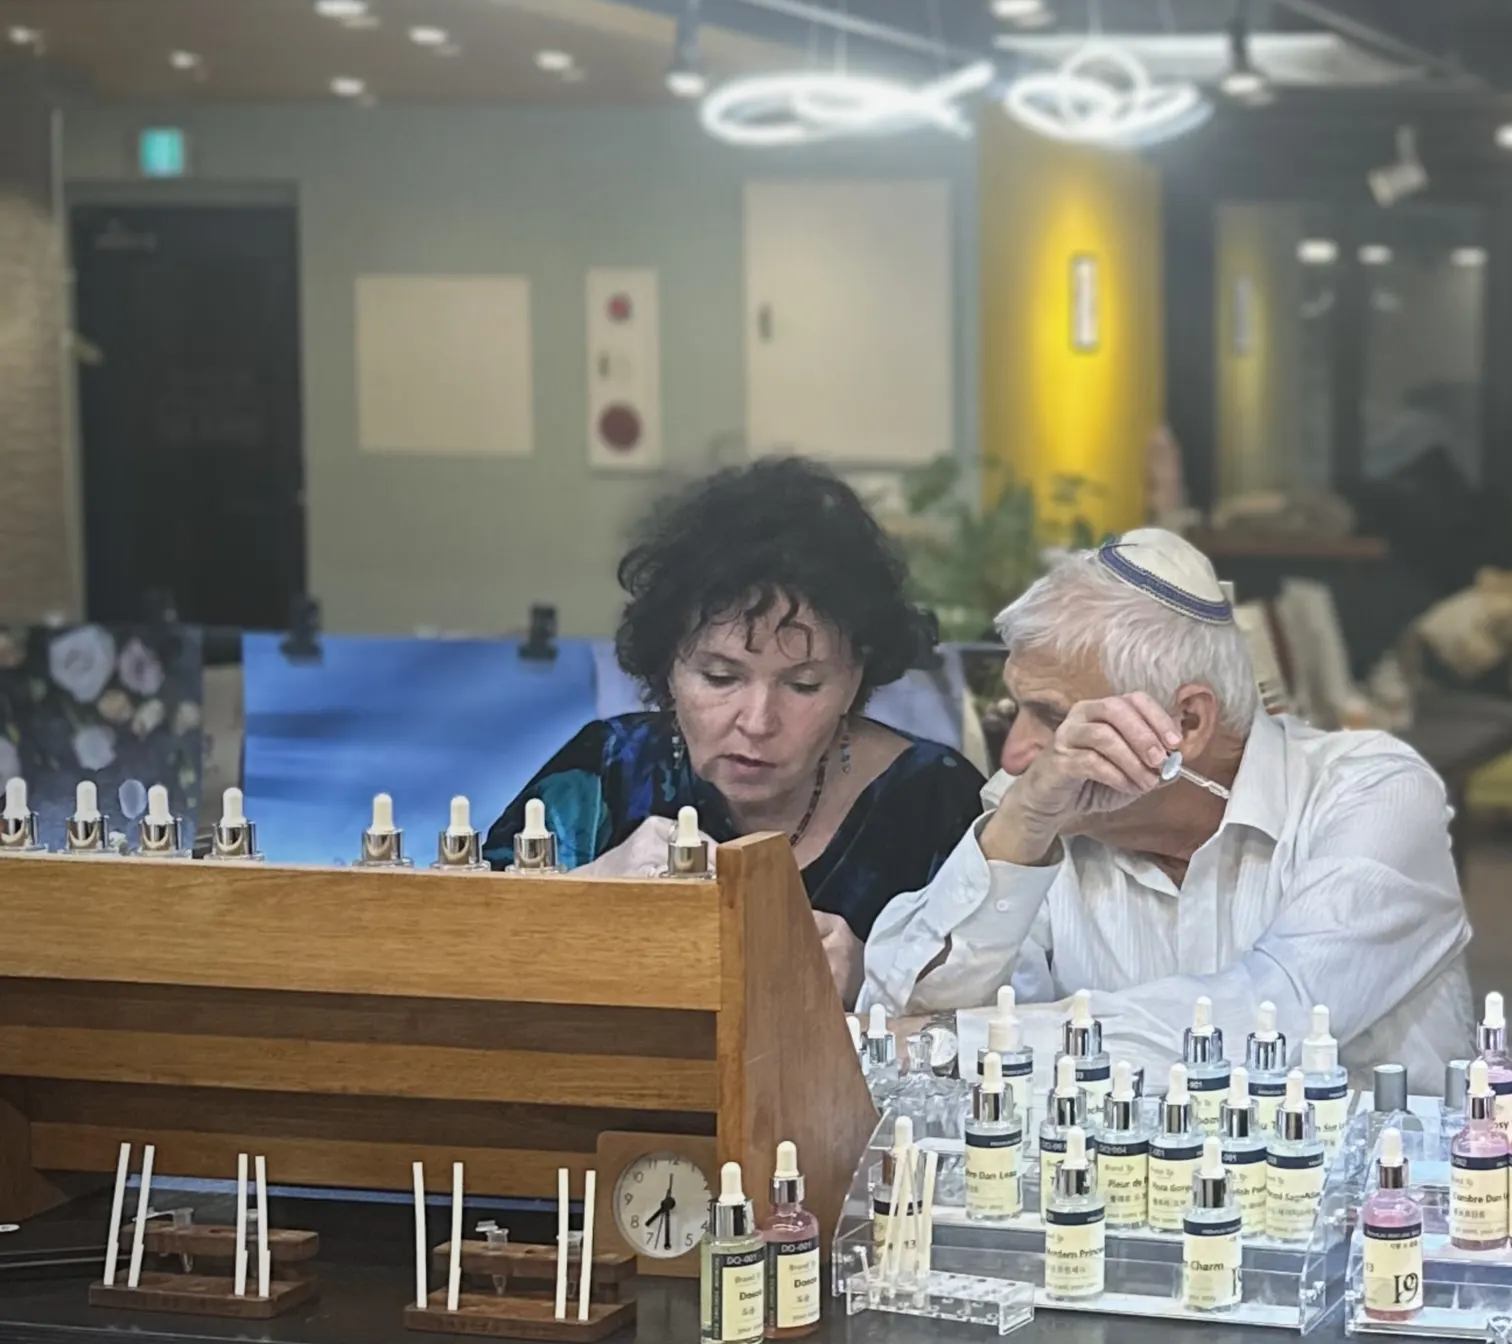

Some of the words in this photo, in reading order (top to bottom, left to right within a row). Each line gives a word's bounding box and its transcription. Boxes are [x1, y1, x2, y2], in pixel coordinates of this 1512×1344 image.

[624, 1193, 633, 1206] 9
[630, 1215, 640, 1229] 8
[646, 1232, 654, 1244] 7
[684, 1233, 693, 1246] 5
[1191, 1260, 1224, 1272] Charm
